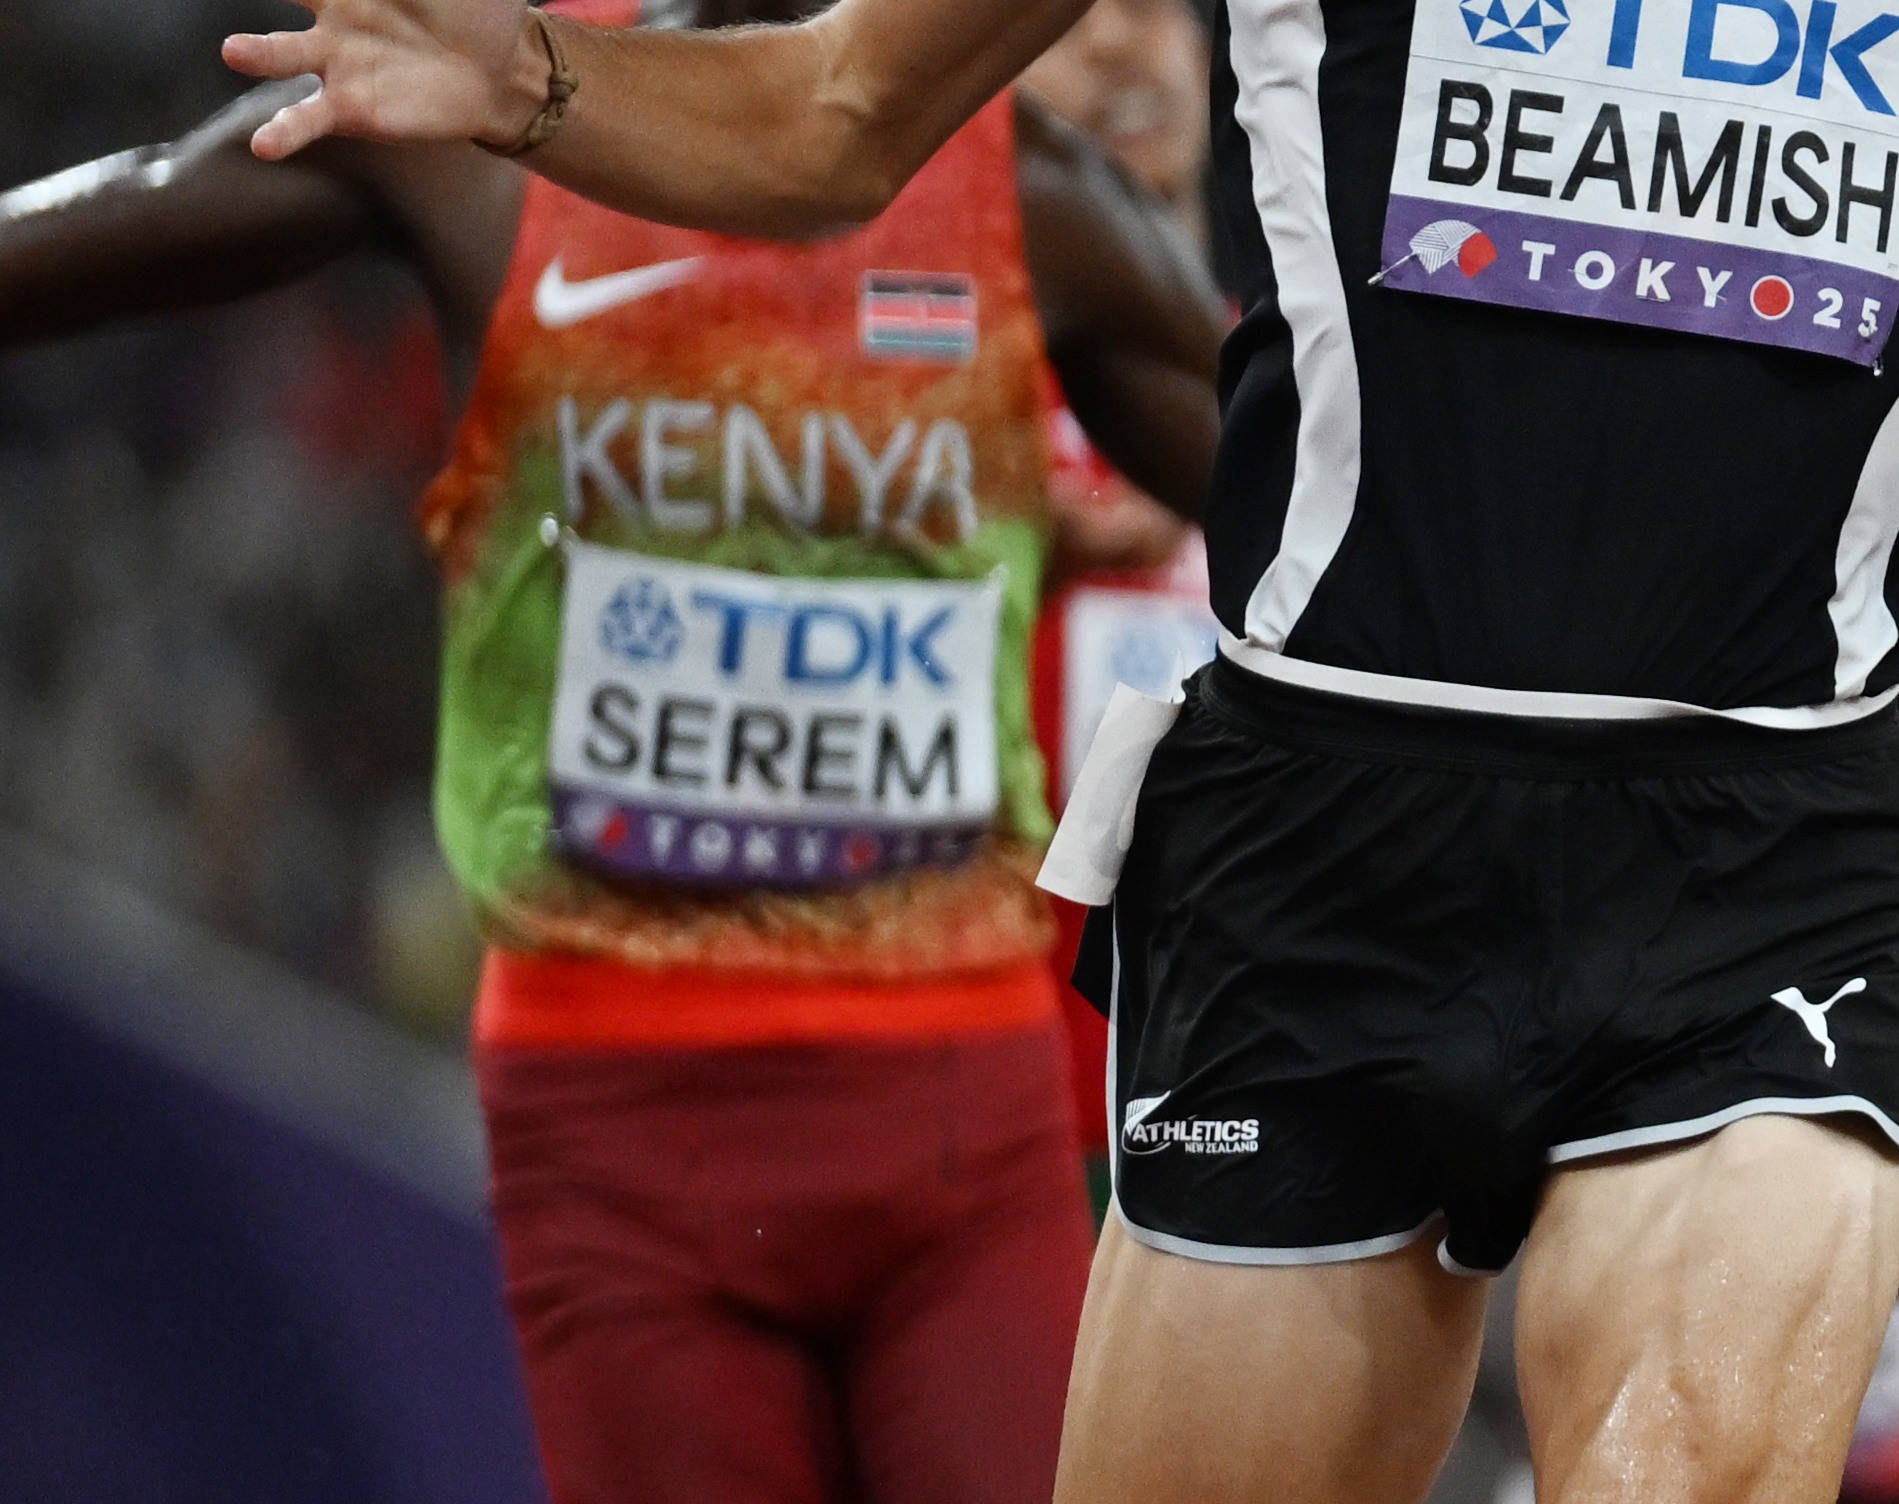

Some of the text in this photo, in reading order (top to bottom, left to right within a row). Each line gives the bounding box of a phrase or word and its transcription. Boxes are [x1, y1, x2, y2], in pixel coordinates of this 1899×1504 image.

[1426, 78, 1899, 255] BEAMISH
[556, 395, 980, 544] KENYA
[690, 590, 957, 692] TDK
[581, 686, 962, 801] SEREM
[1131, 1119, 1260, 1143] ATHLETICS
[1184, 1140, 1259, 1154] NEW ZEALAND
